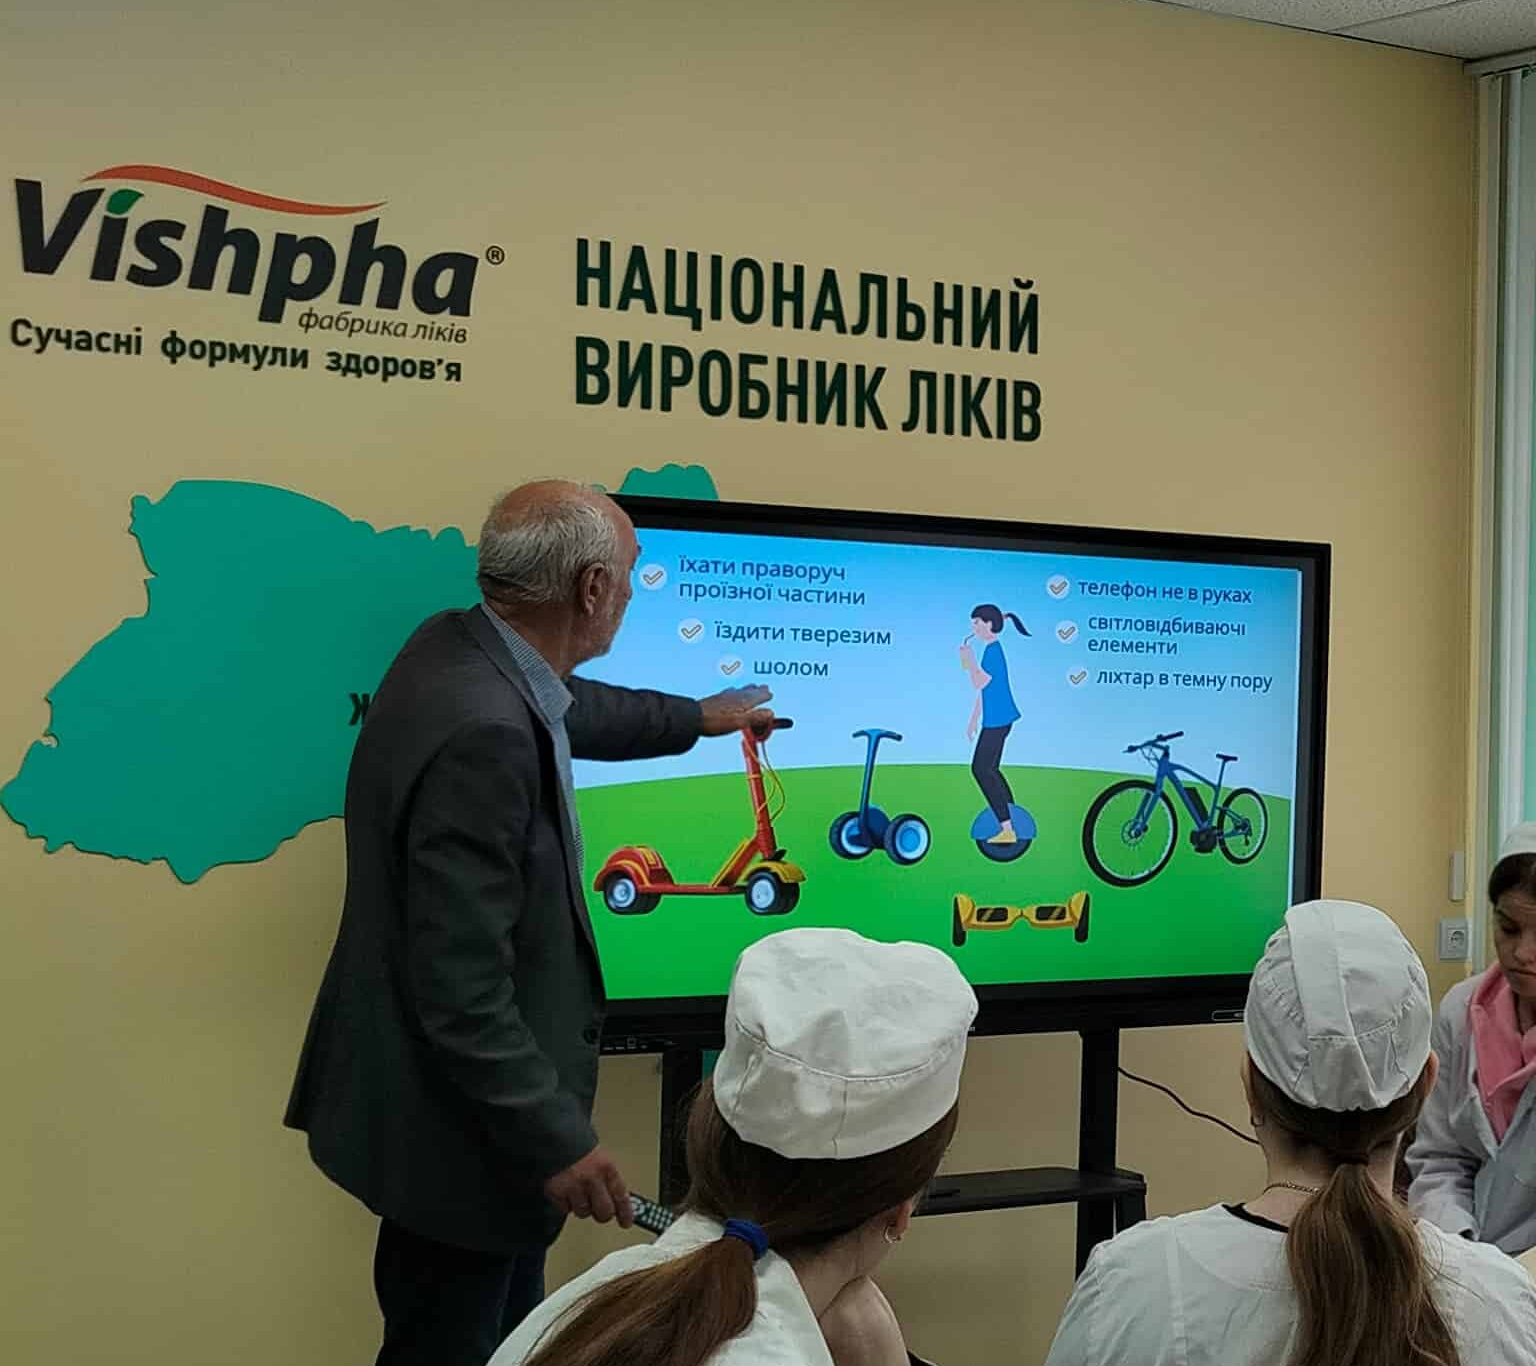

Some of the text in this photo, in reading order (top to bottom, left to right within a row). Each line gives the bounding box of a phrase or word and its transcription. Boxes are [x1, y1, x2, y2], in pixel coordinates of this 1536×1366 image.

[575, 237, 1040, 355] НАЦІОНАЛЬНИЙ
[298, 306, 468, 345] фабрика ліків
[10, 318, 143, 356] Сучасні
[160, 328, 310, 372] формули
[575, 335, 1042, 443] ВИРОБНИК ЛІКІВ
[679, 555, 846, 584] їхати праворуч
[679, 582, 866, 605] проїзної частини
[1078, 580, 1252, 605] телефон не в руках
[715, 620, 892, 647] їздити тверезим
[1088, 614, 1247, 637] світловідбиваючі
[1087, 638, 1178, 654] елементи
[753, 659, 829, 676] шолом
[1096, 669, 1273, 692] ліхтар в темну пору
